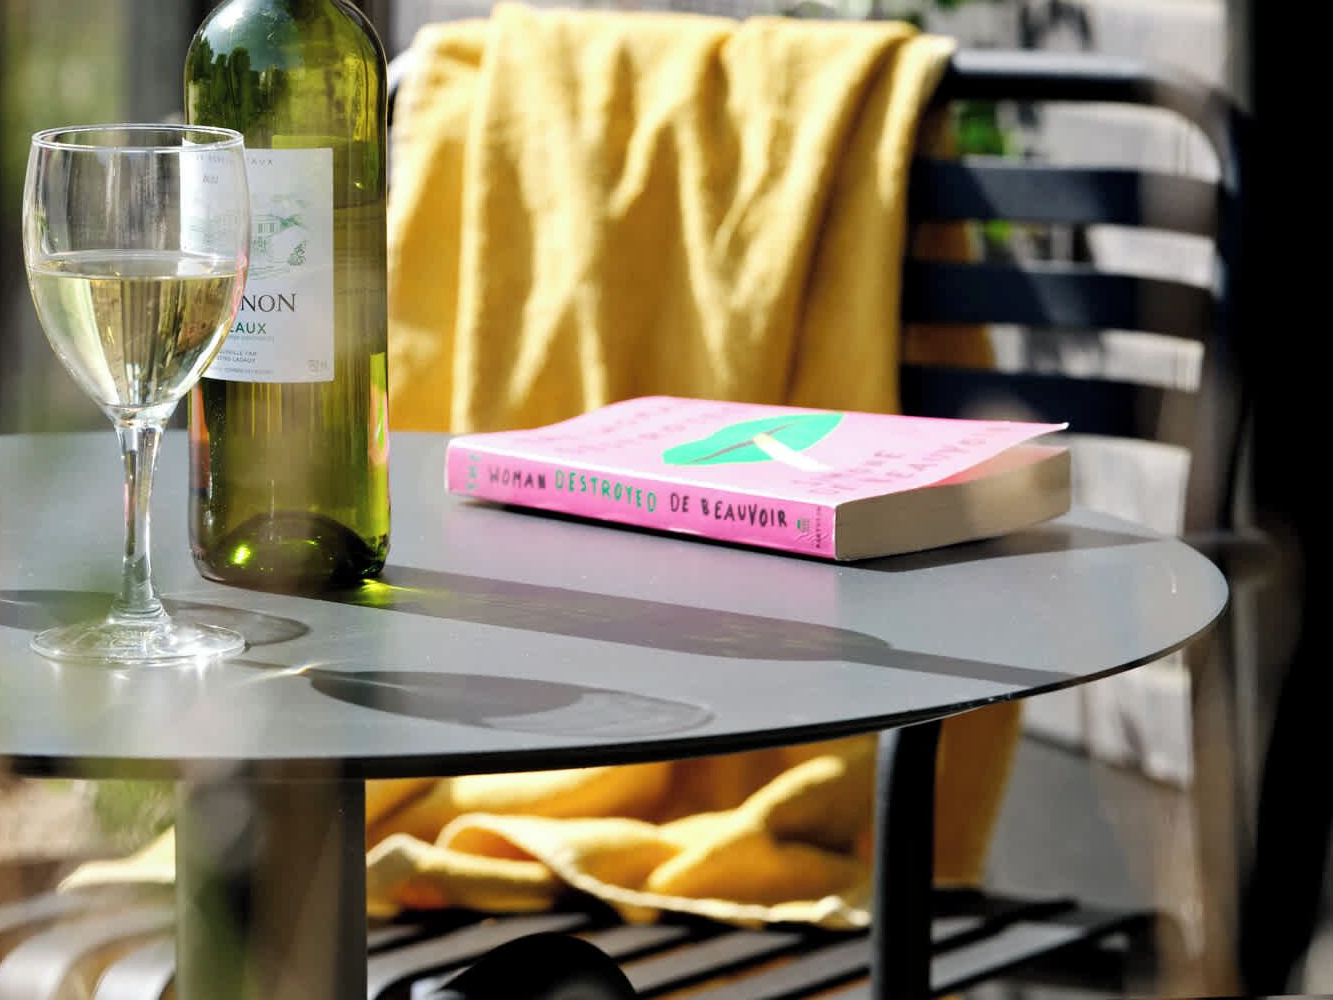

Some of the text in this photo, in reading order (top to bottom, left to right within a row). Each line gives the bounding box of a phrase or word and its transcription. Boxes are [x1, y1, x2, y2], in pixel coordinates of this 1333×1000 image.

[488, 465, 546, 489] WOMAN
[555, 469, 657, 513] DESTROYED
[670, 492, 690, 513] DE
[700, 497, 788, 528] BEAUVOIR
